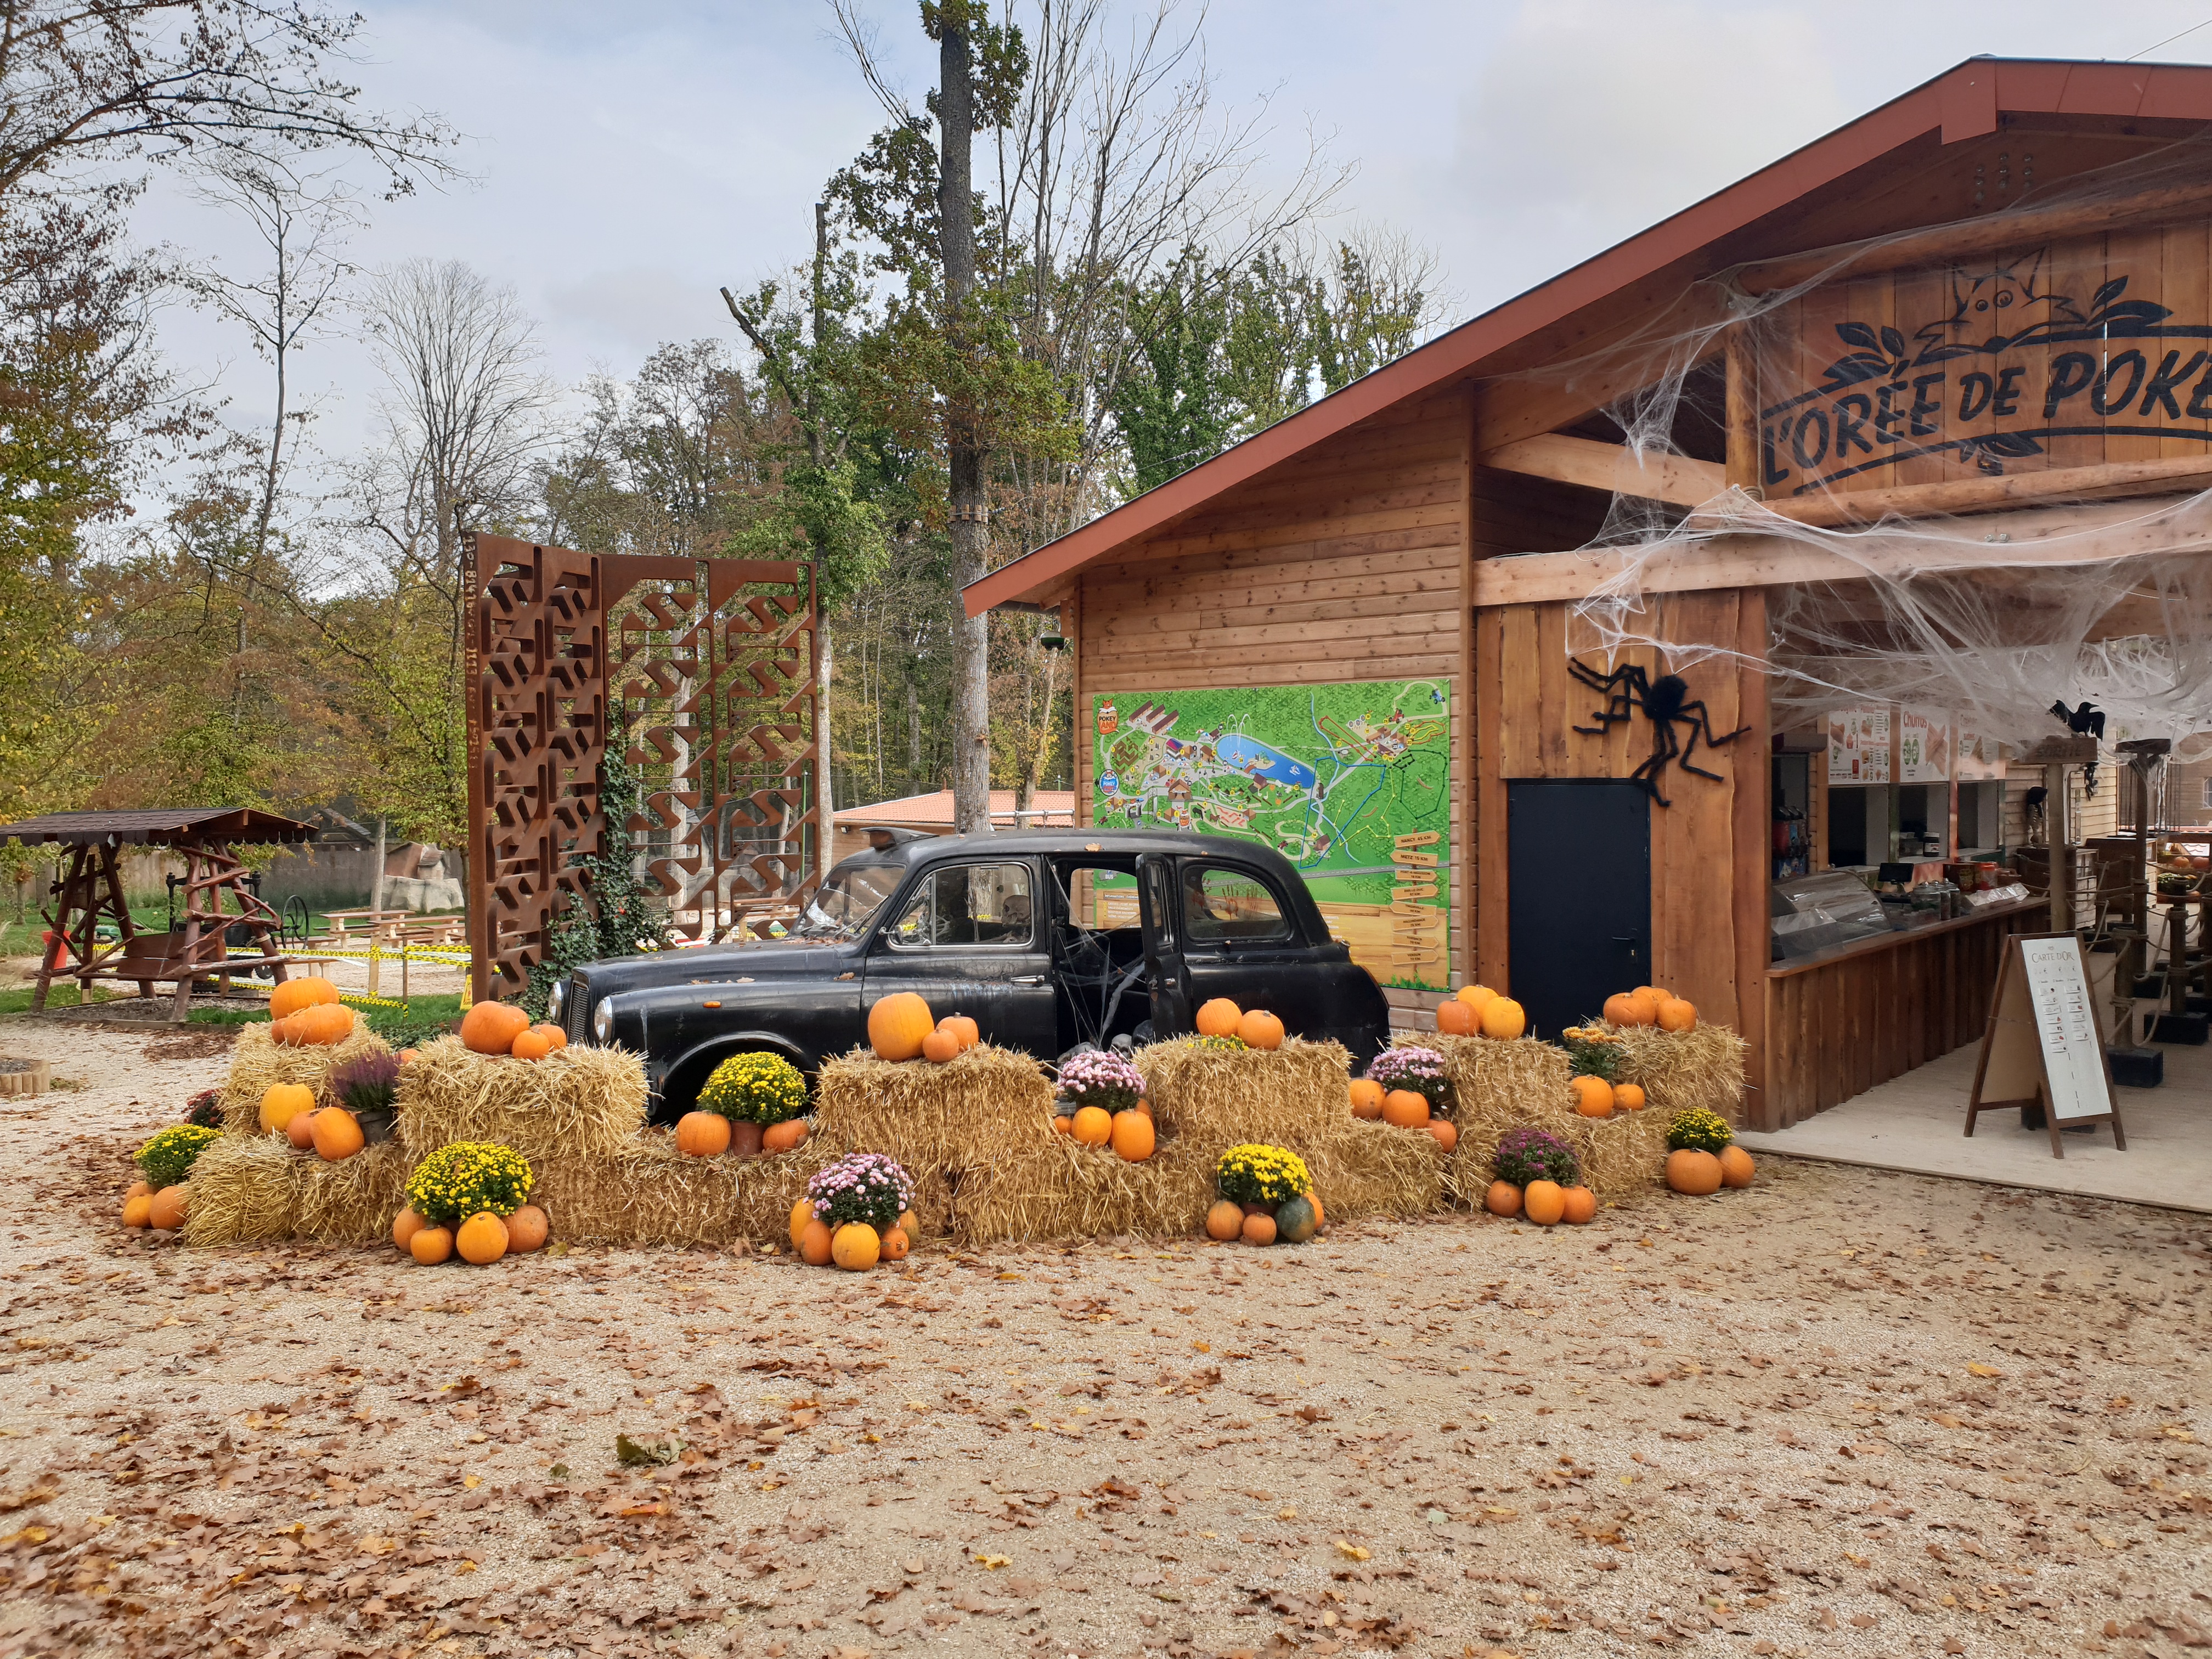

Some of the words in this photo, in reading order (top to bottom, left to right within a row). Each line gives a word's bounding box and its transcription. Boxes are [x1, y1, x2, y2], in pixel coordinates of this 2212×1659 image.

[1764, 360, 1945, 485] L'ORÉE
[1959, 366, 2025, 421] DE
[2032, 953, 2055, 963] CARTE
